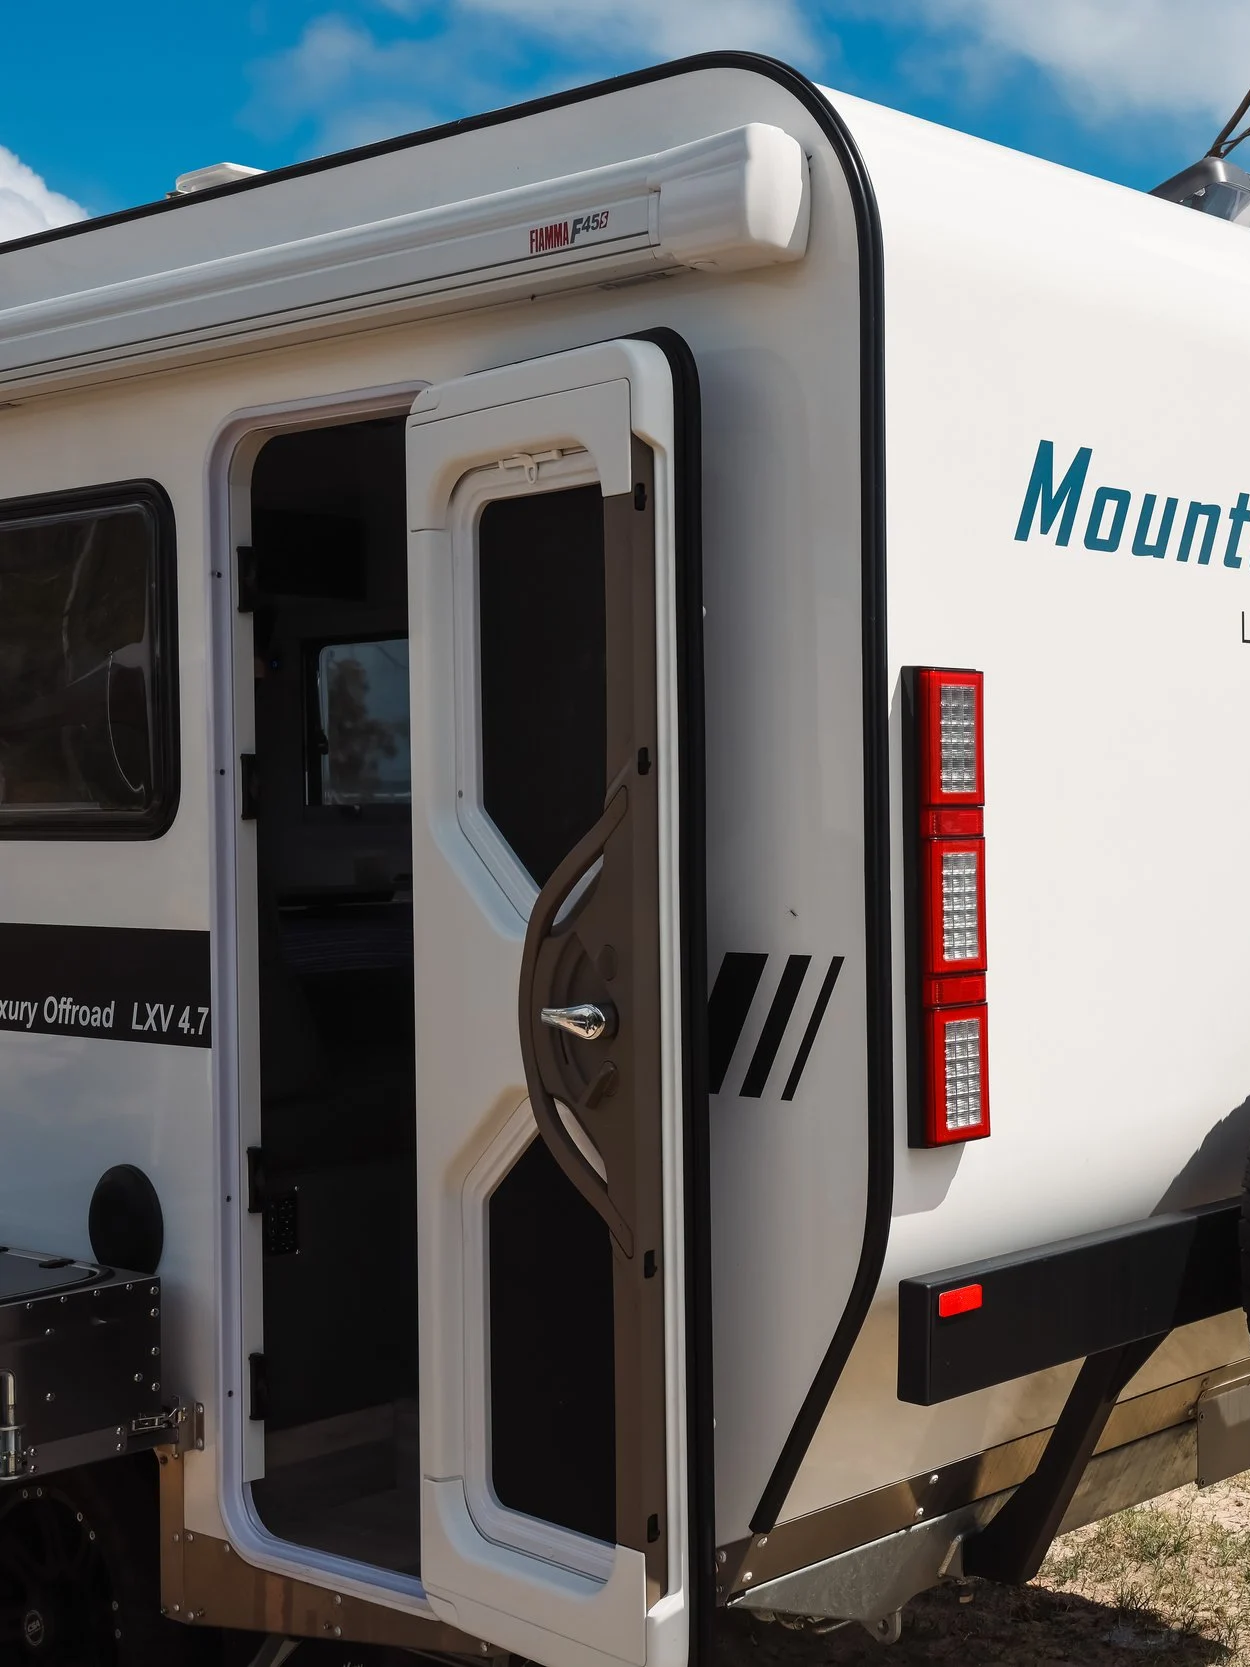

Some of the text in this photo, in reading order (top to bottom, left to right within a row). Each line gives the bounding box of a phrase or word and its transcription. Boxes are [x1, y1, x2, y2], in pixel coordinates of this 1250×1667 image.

[529, 221, 569, 254] FIAMMA
[43, 996, 115, 1028] Offroad
[131, 1002, 175, 1032] LXV
[178, 1005, 209, 1035] 4.7
